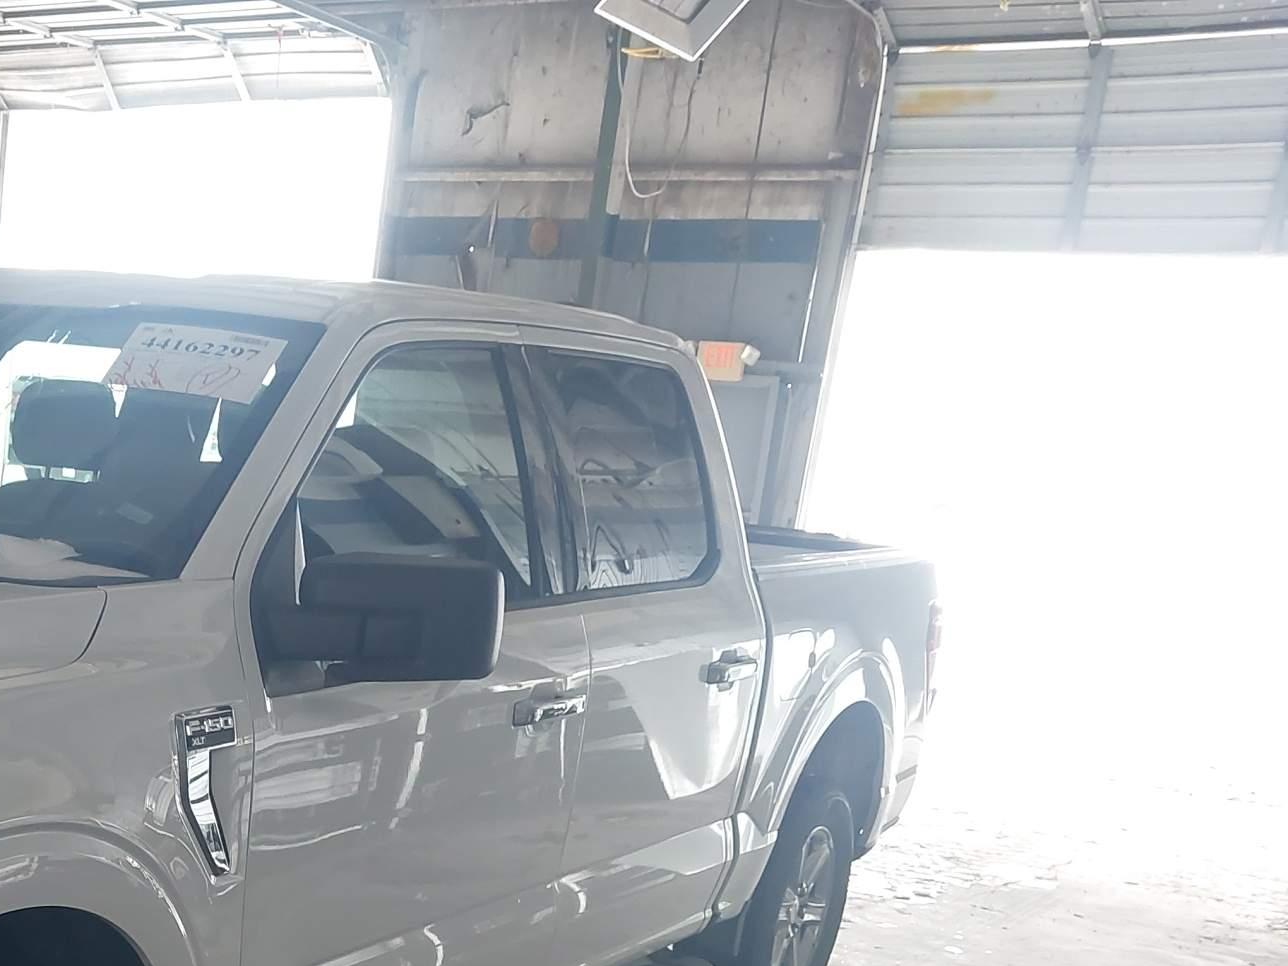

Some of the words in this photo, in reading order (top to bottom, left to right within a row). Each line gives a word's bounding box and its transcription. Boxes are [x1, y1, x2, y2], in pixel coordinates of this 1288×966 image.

[141, 335, 261, 361] 44162297
[186, 715, 233, 737] F-150
[191, 736, 206, 747] XLT
